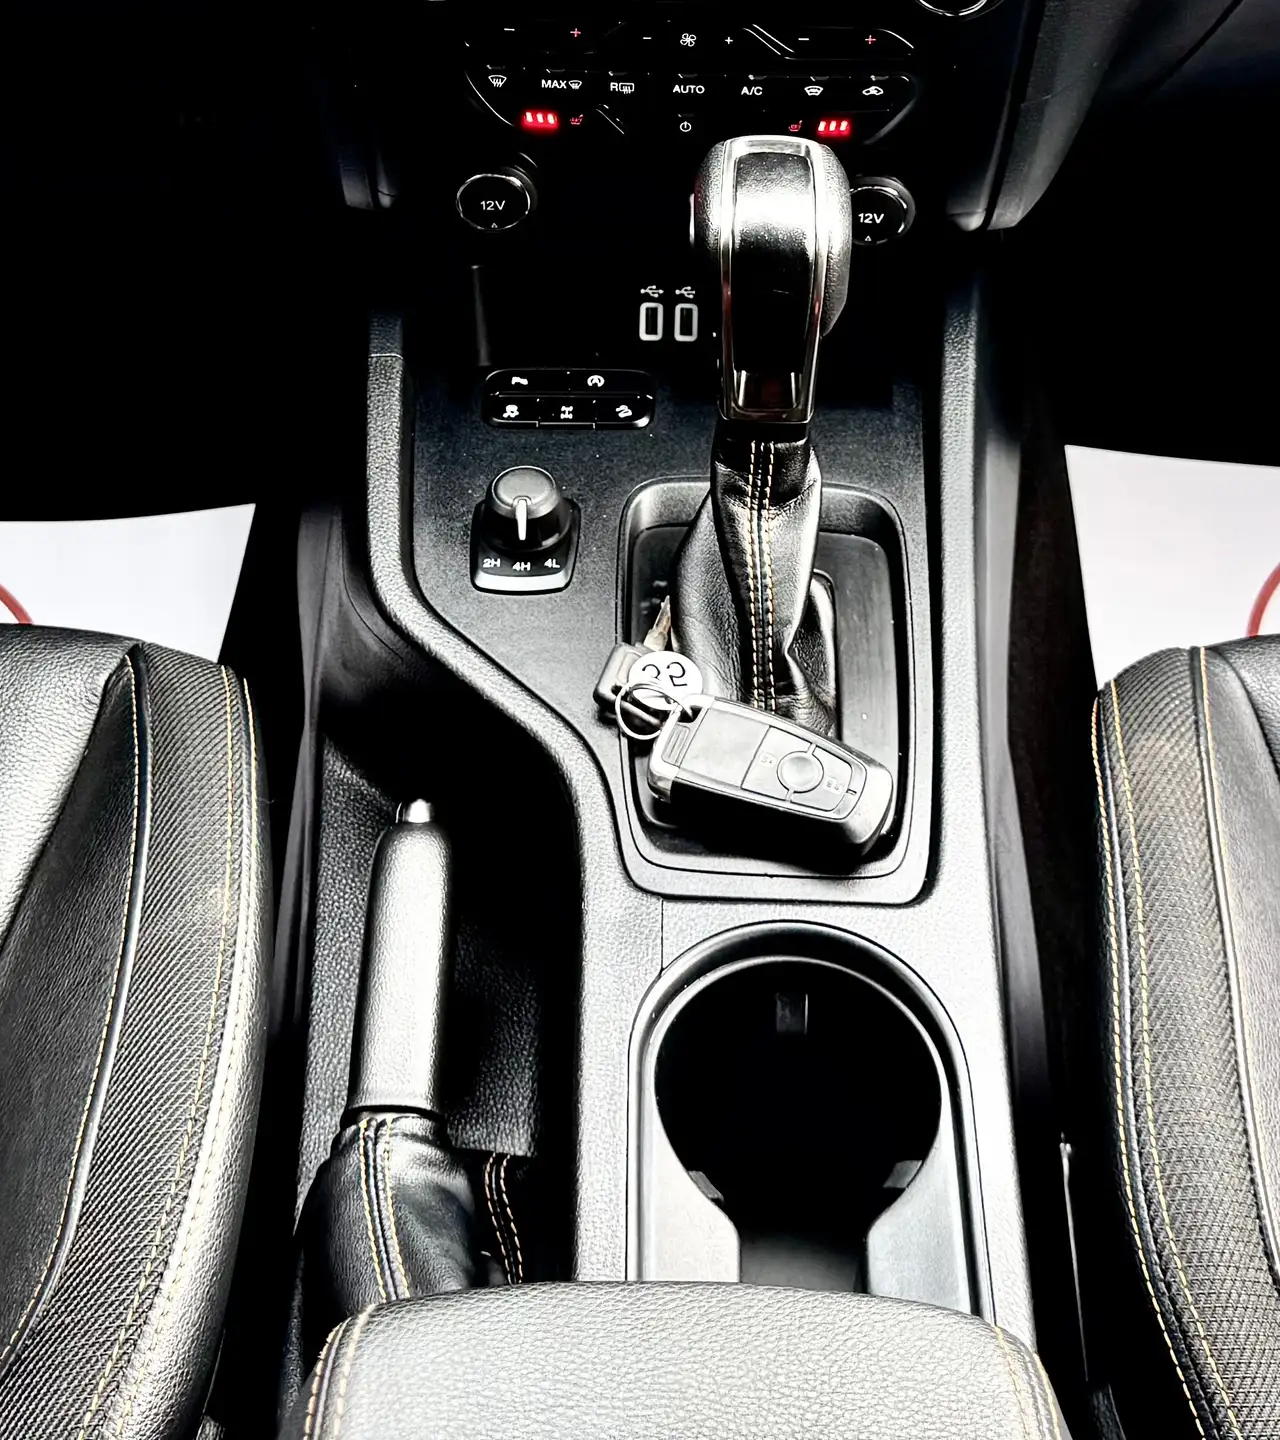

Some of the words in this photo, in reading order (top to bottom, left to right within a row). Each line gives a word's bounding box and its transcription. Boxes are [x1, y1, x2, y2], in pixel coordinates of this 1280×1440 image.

[541, 78, 567, 90] MAX
[610, 82, 619, 92] R
[672, 84, 705, 95] AUTO
[740, 85, 763, 97] A/C
[480, 200, 506, 211] 12V
[857, 212, 885, 225] 12V
[482, 558, 500, 568] 2H
[512, 561, 531, 571] 4H
[543, 558, 561, 568] 4L
